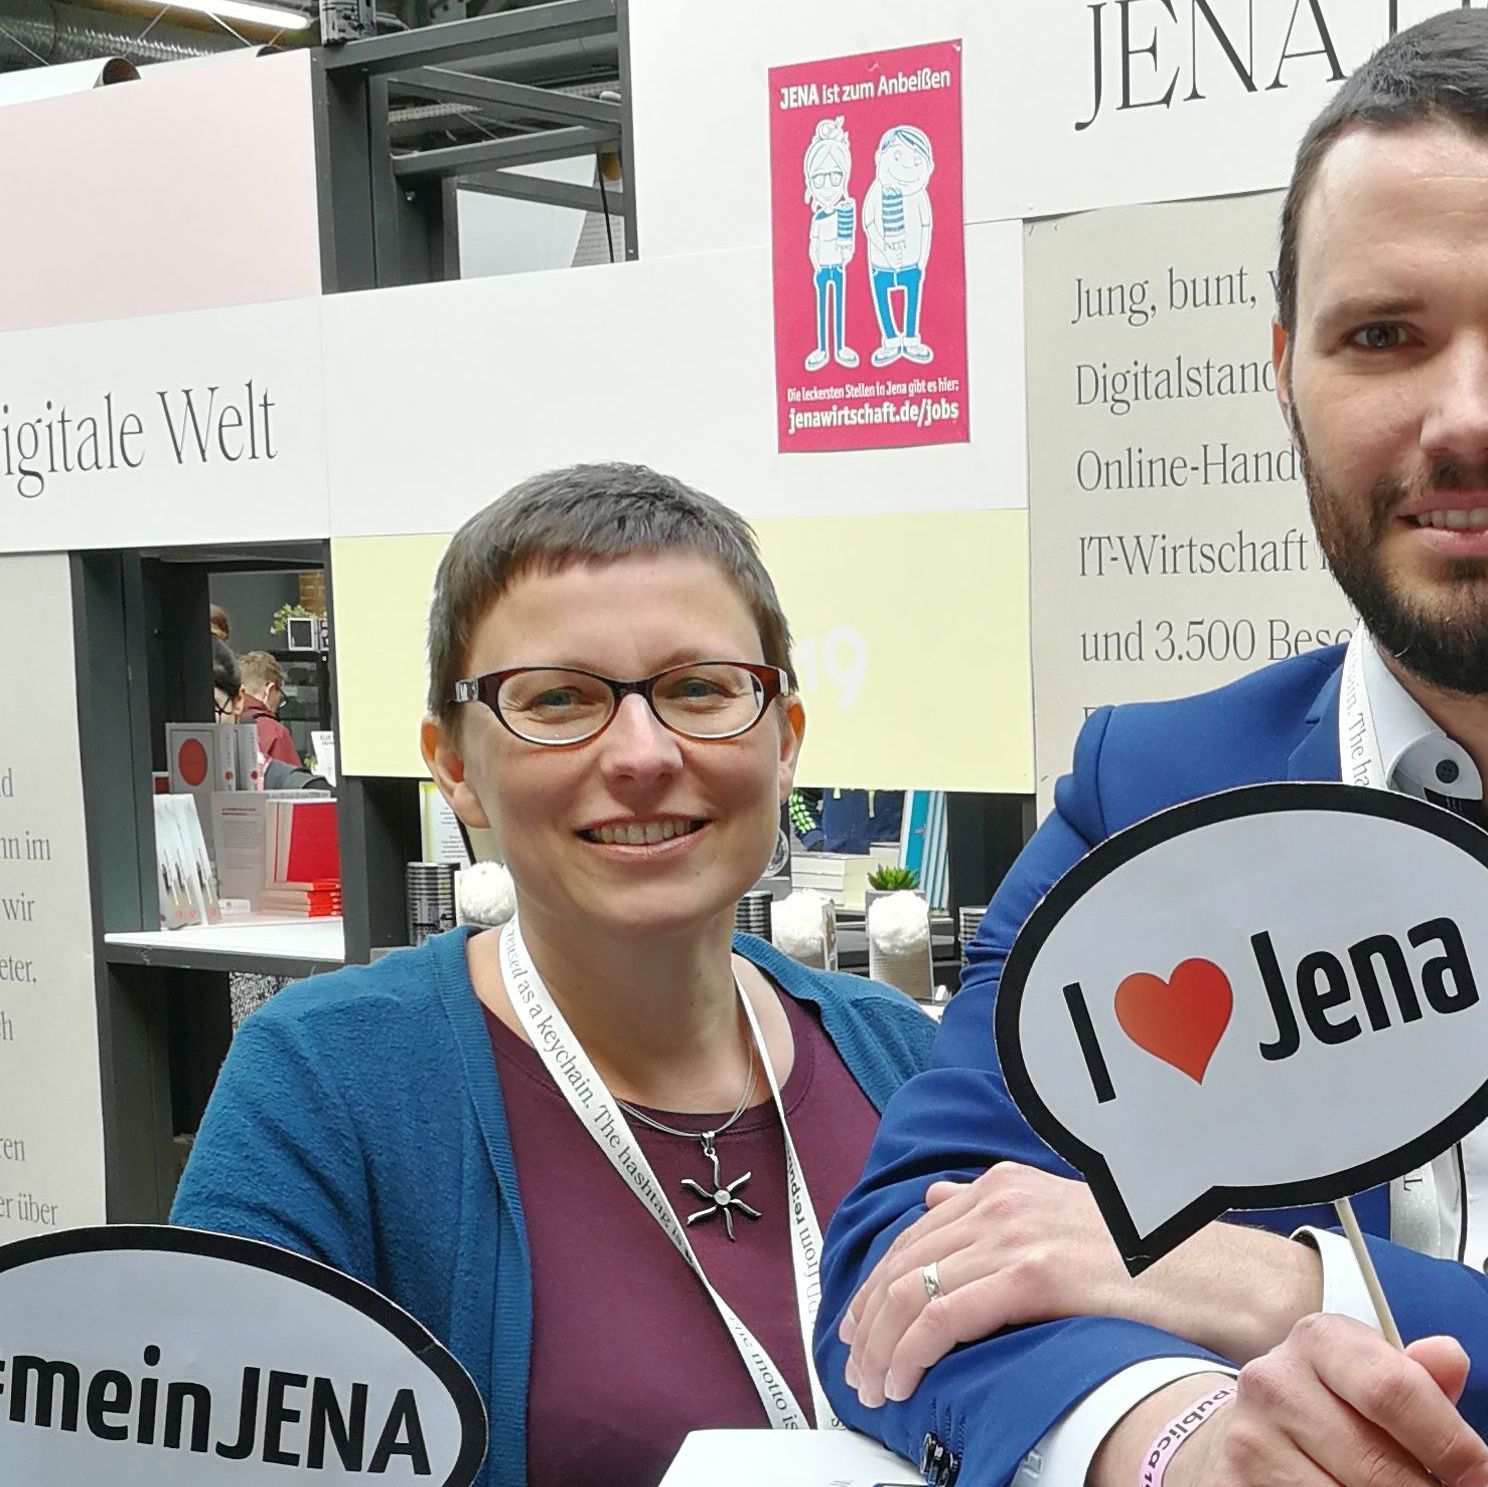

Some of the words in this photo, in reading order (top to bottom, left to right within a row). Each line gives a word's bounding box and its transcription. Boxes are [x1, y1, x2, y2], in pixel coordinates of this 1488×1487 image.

[779, 84, 820, 110] JENA
[822, 84, 840, 104] ist
[842, 83, 875, 103] zum
[877, 67, 951, 97] Anbeißen
[1075, 0, 1347, 131] JENA
[1071, 278, 1157, 327] Jung,
[1167, 265, 1257, 310] bunt,
[787, 388, 801, 402] Die
[802, 386, 845, 401] leckersten
[845, 382, 875, 399] Stellen
[876, 382, 885, 397] in
[886, 381, 907, 396] Jena
[908, 379, 926, 397] gibt
[927, 380, 937, 393] es
[938, 376, 960, 393] hier:
[156, 379, 278, 465] Welt
[788, 398, 959, 435] jenawirtschaft.de/jobs
[1076, 443, 1302, 492] Online-Hand
[1079, 528, 1310, 577] IT-Wirtschaft
[1081, 620, 1144, 663] und
[1154, 619, 1256, 663] 3.500
[1348, 712, 1367, 758] The
[26, 830, 50, 861] im
[2, 892, 35, 922] wir
[1062, 982, 1117, 1104] I
[1250, 916, 1481, 1062] Jena
[518, 979, 535, 1004] as
[529, 1004, 543, 1020] a
[537, 1015, 596, 1109] keychain.
[594, 1104, 621, 1149] The
[18, 1192, 58, 1225] über
[751, 1353, 787, 1411] motto
[0, 1345, 431, 1476] meinJENA
[1142, 1388, 1236, 1487] publica1
